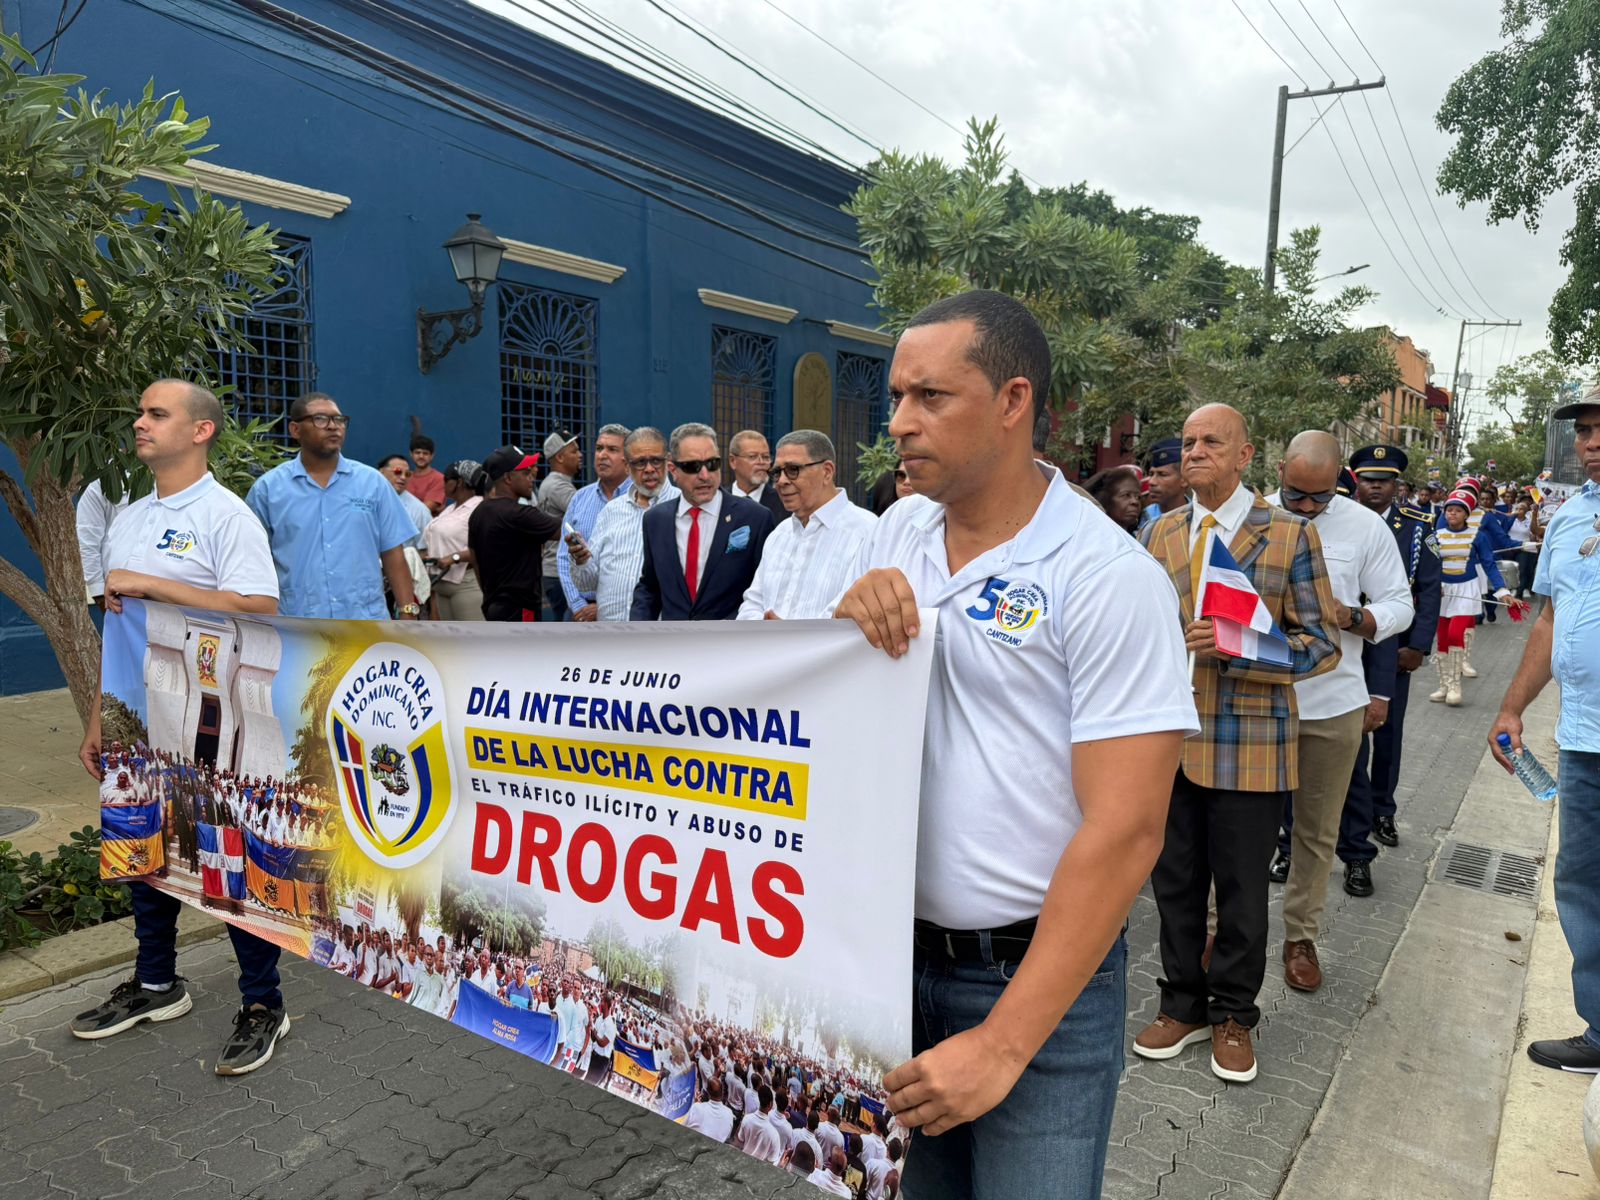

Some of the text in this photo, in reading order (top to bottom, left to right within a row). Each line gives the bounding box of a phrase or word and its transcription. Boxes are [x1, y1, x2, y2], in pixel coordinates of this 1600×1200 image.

[986, 628, 1022, 646] CANTIZANO
[342, 660, 433, 721] HOGAR CREA
[351, 684, 419, 731] DOMINICANO
[560, 667, 681, 689] 26 DE JUNIO
[372, 710, 395, 728] INC.
[466, 681, 811, 748] DÍA INTERNACIONAL
[472, 735, 794, 806] DE LA LUCHA CONTRA
[472, 778, 804, 852] EL TRÁFICO ILÍCITO Y ABUSO DE
[470, 801, 805, 959] DROGAS
